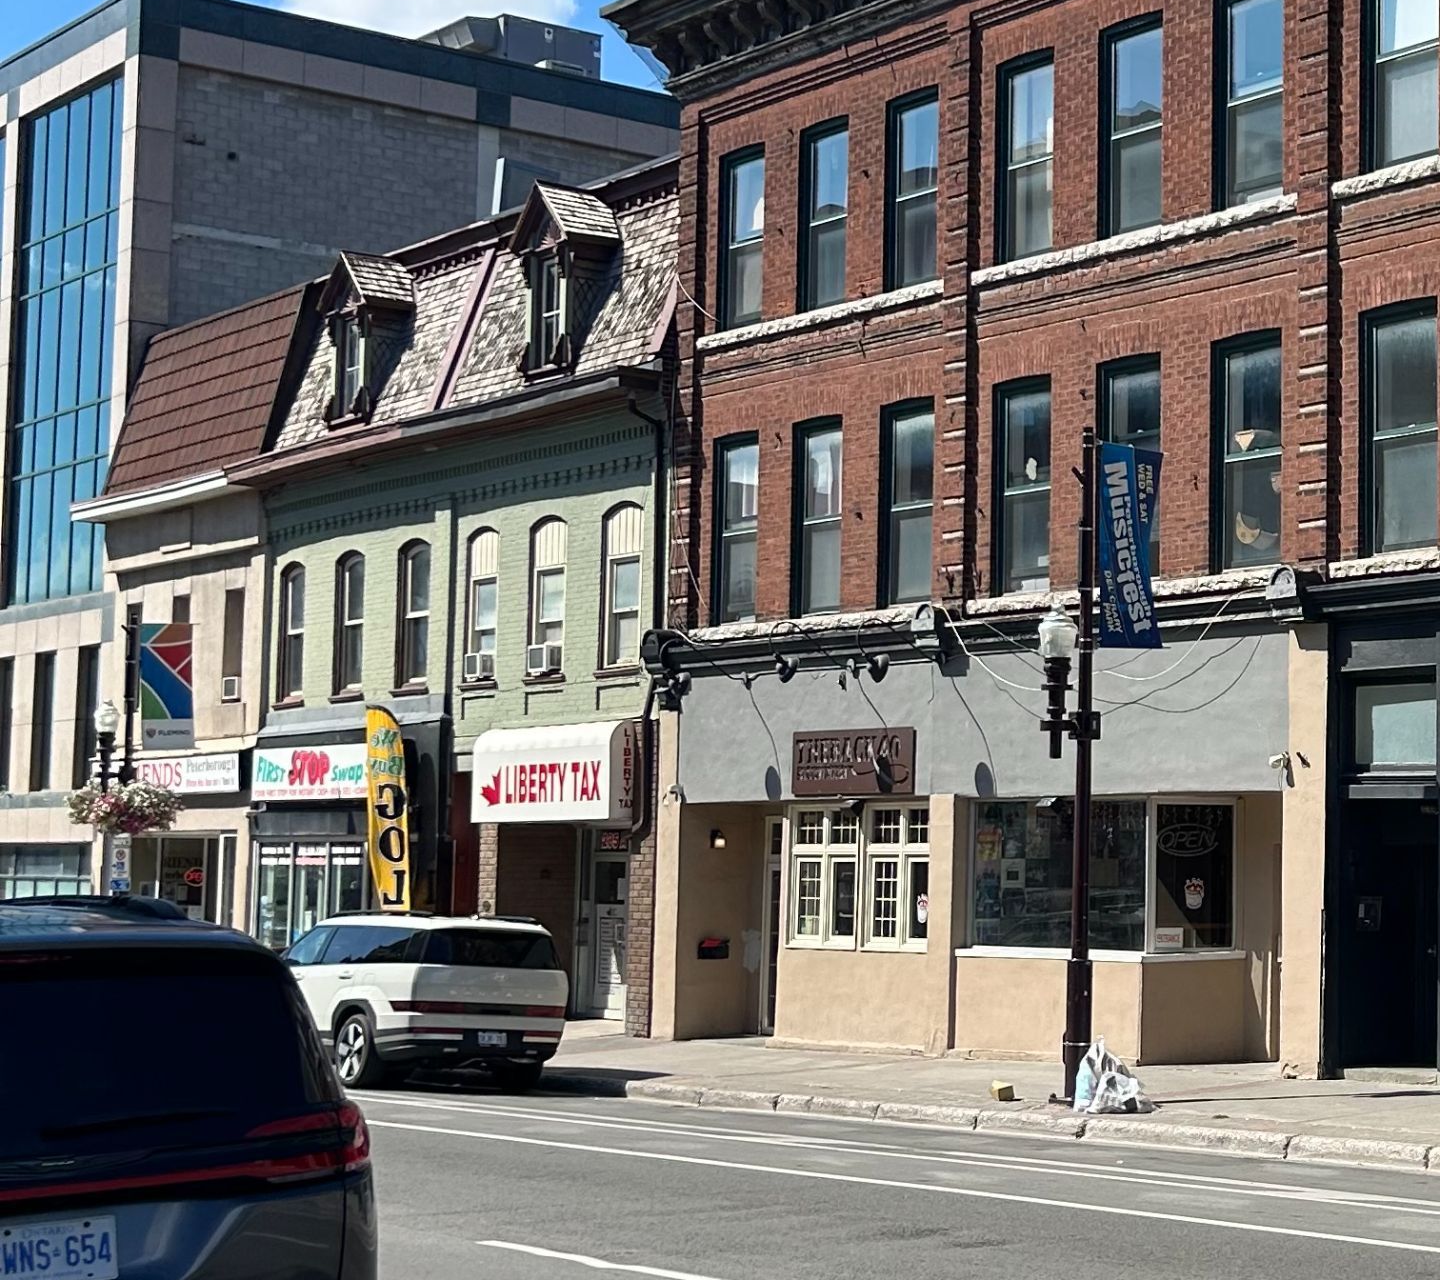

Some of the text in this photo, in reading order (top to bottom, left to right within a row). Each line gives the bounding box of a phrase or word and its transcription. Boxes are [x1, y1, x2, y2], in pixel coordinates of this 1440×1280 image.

[1137, 463, 1146, 489] WED
[1146, 465, 1155, 495] FREE
[1140, 503, 1148, 524] SAT
[1104, 461, 1153, 634] Musicfest
[1104, 570, 1115, 594] DEL
[256, 755, 286, 783] FIRST
[288, 749, 330, 786] STOP
[623, 728, 632, 796] LIBERTY
[505, 760, 602, 805] LIBERTY TAX
[1159, 830, 1217, 850] OPEN
[65, 1231, 112, 1267] 654
